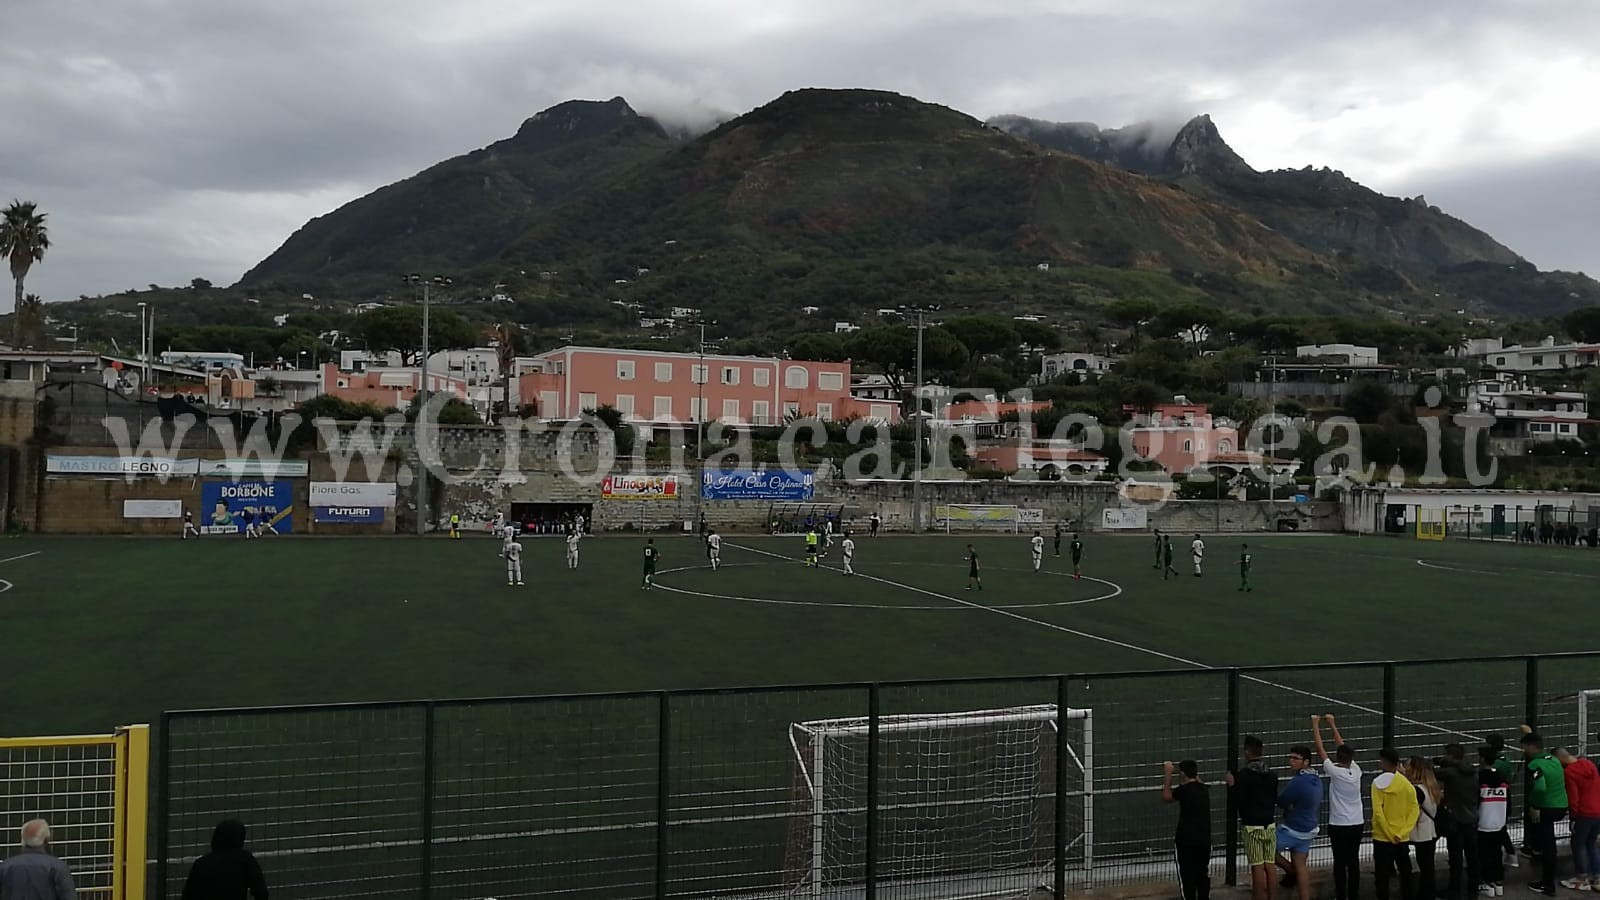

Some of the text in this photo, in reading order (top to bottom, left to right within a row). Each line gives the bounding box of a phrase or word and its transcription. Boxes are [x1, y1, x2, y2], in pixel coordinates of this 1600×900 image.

[122, 462, 170, 472] LEGNO
[712, 475, 744, 489] Hotel
[221, 486, 275, 497] BORBONE
[312, 486, 361, 494] Fiore Gas
